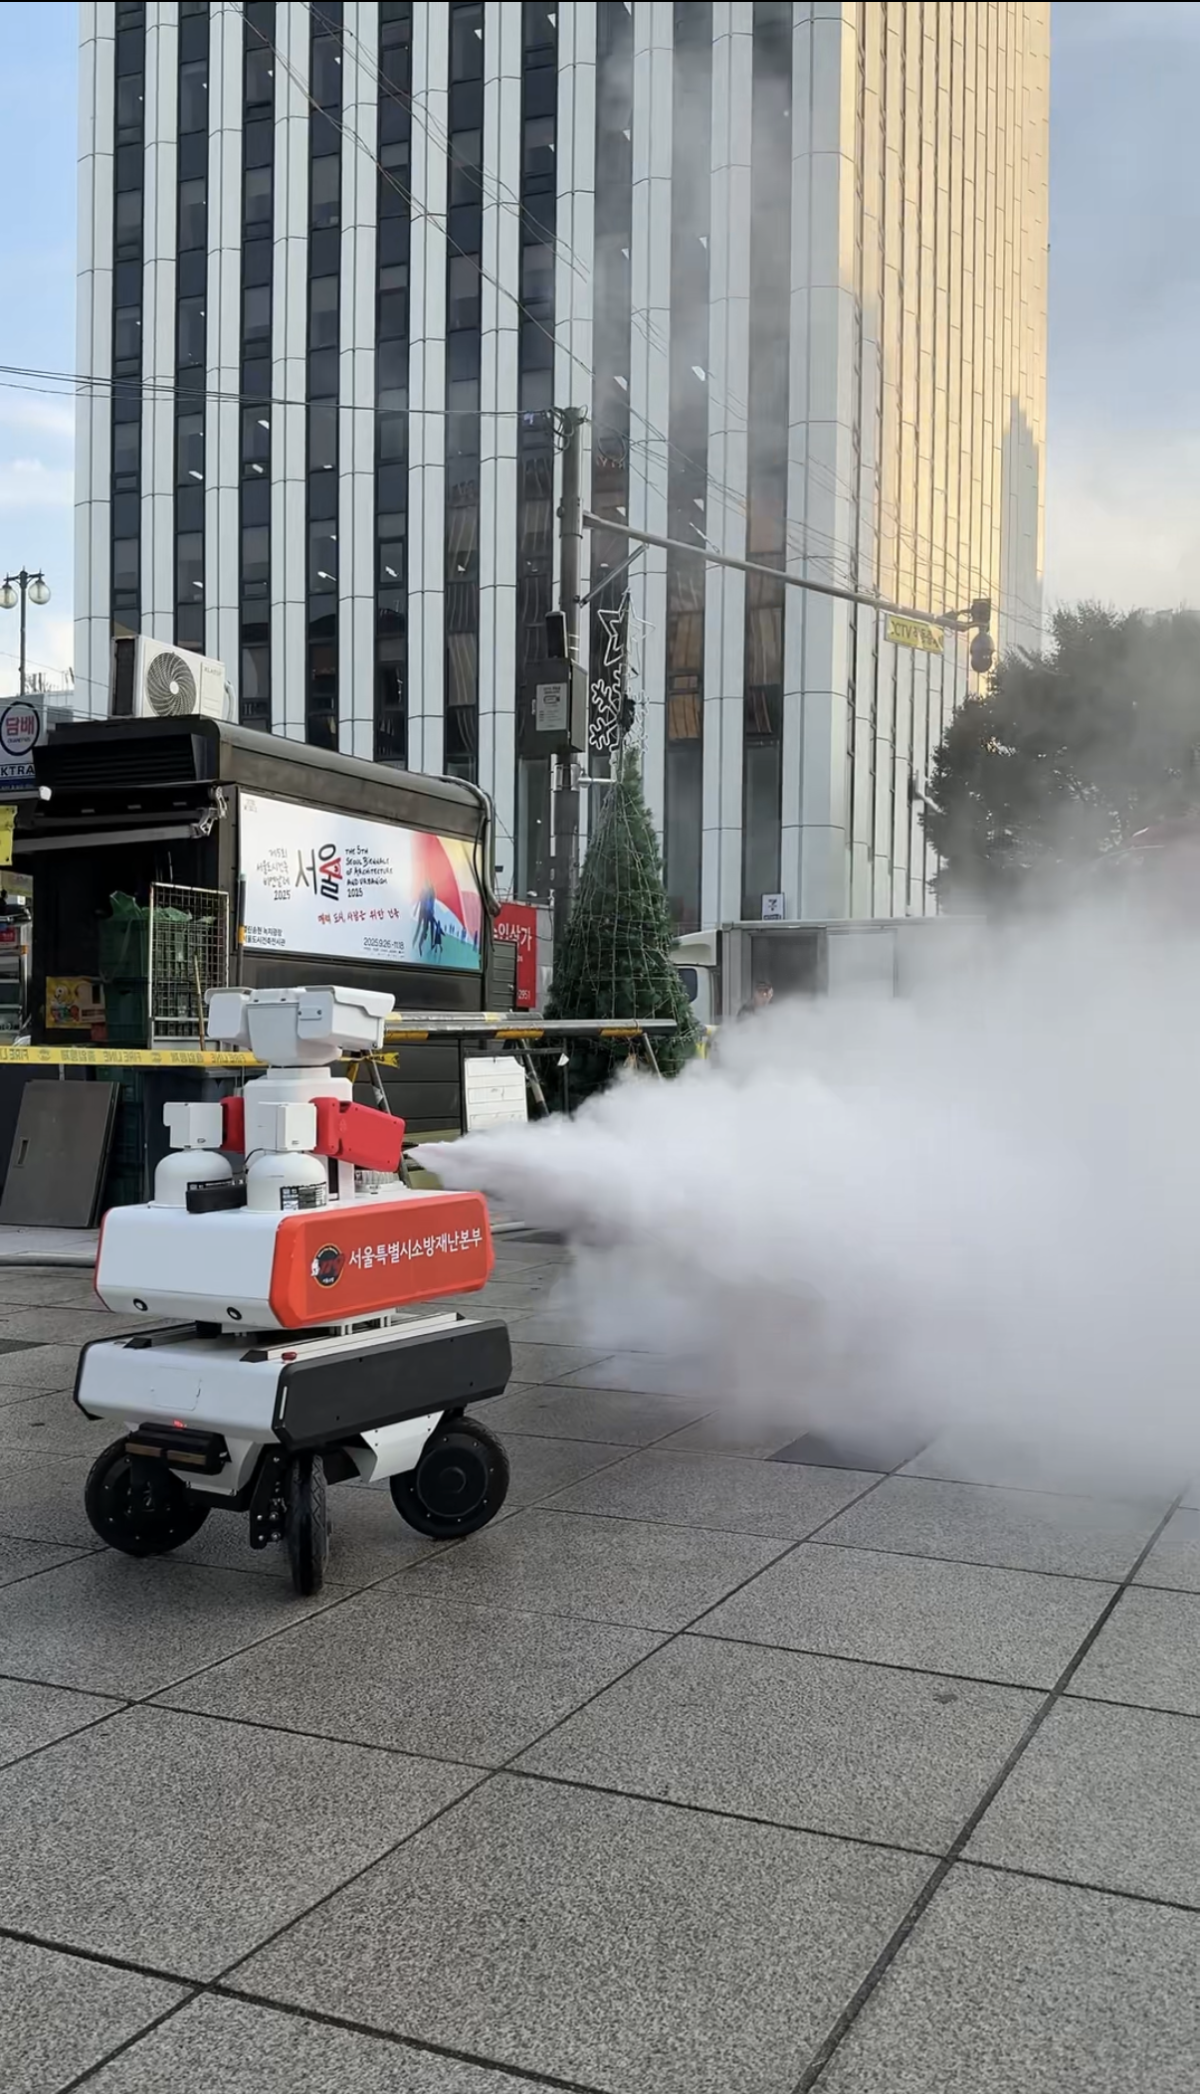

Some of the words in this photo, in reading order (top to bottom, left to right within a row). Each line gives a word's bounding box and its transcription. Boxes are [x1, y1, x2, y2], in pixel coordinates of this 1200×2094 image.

[6, 715, 35, 736] 담배
[1, 765, 36, 776] KTRA
[295, 843, 343, 901] 서울
[273, 889, 291, 901] 2025
[347, 888, 364, 898] 2025
[369, 908, 384, 920] 위한
[245, 935, 286, 947] 울도시건축전시관
[348, 1228, 483, 1270] 서울특별시소방재난본부
